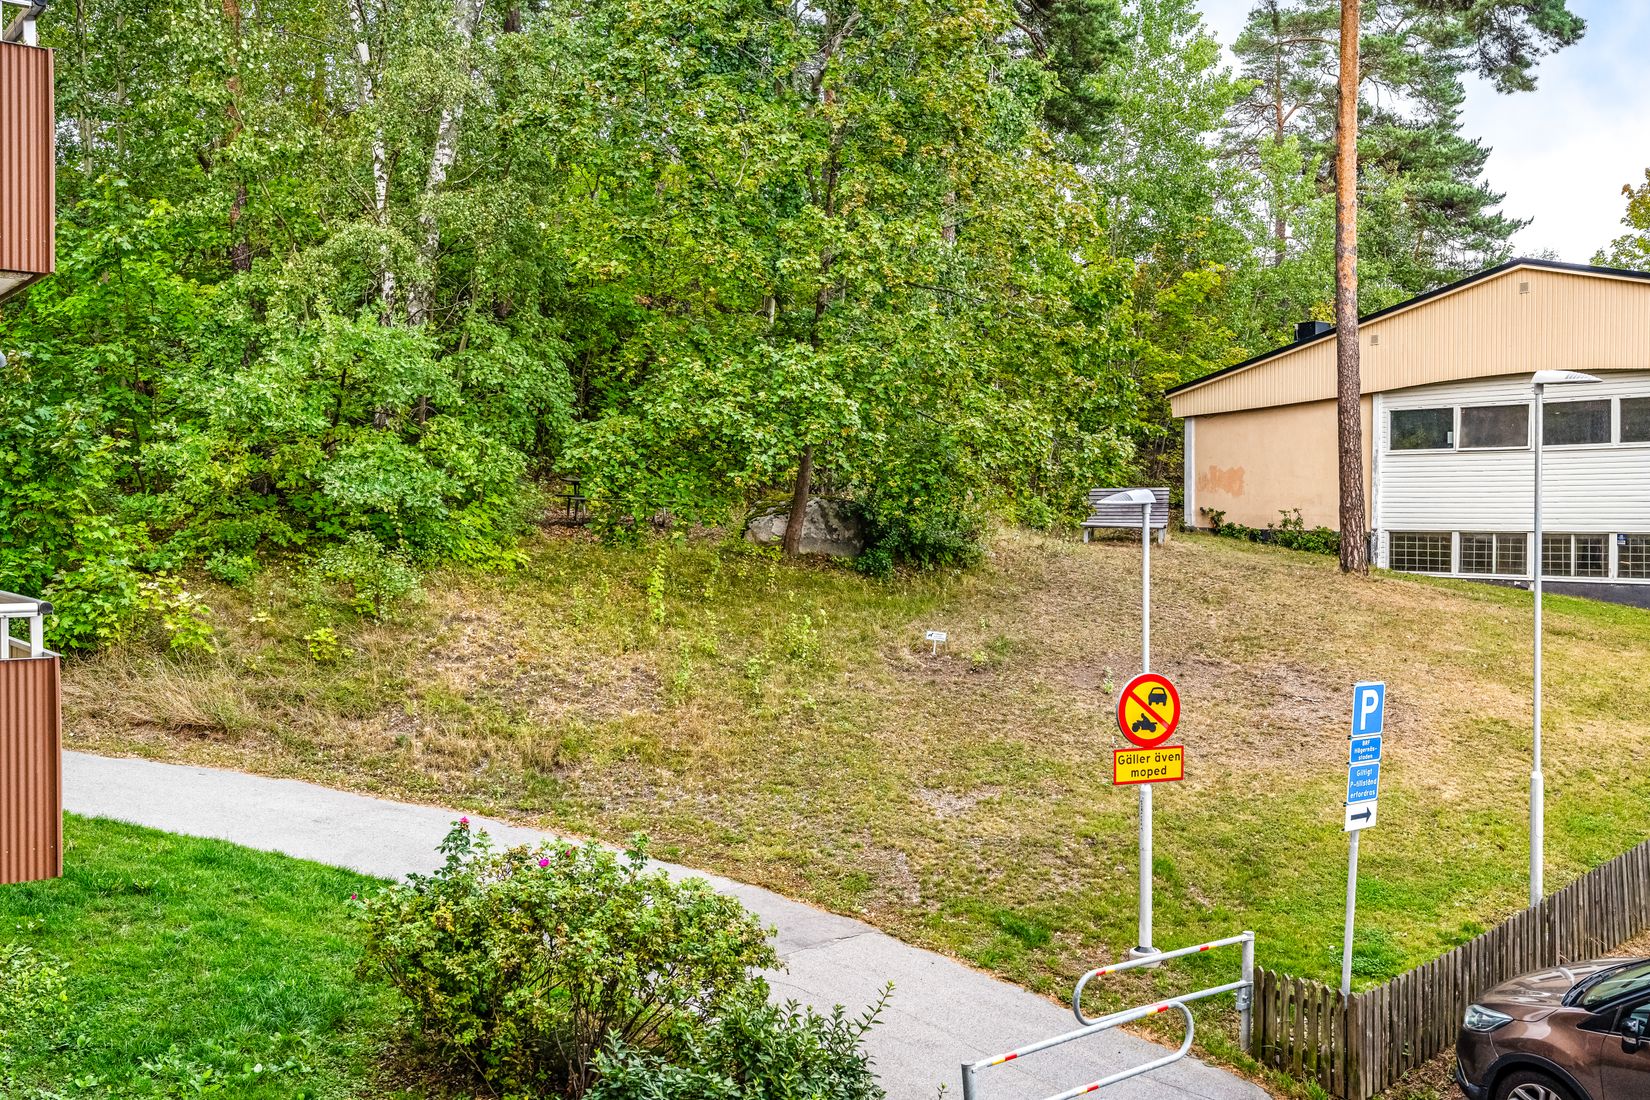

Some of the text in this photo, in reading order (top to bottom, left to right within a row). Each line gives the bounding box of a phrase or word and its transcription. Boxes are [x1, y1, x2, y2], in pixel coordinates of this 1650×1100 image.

[1360, 689, 1379, 731] P
[1117, 752, 1181, 765] Gäller även
[1130, 765, 1167, 778] moped
[1356, 768, 1373, 777] Giltigt
[1350, 790, 1376, 799] erfordras
